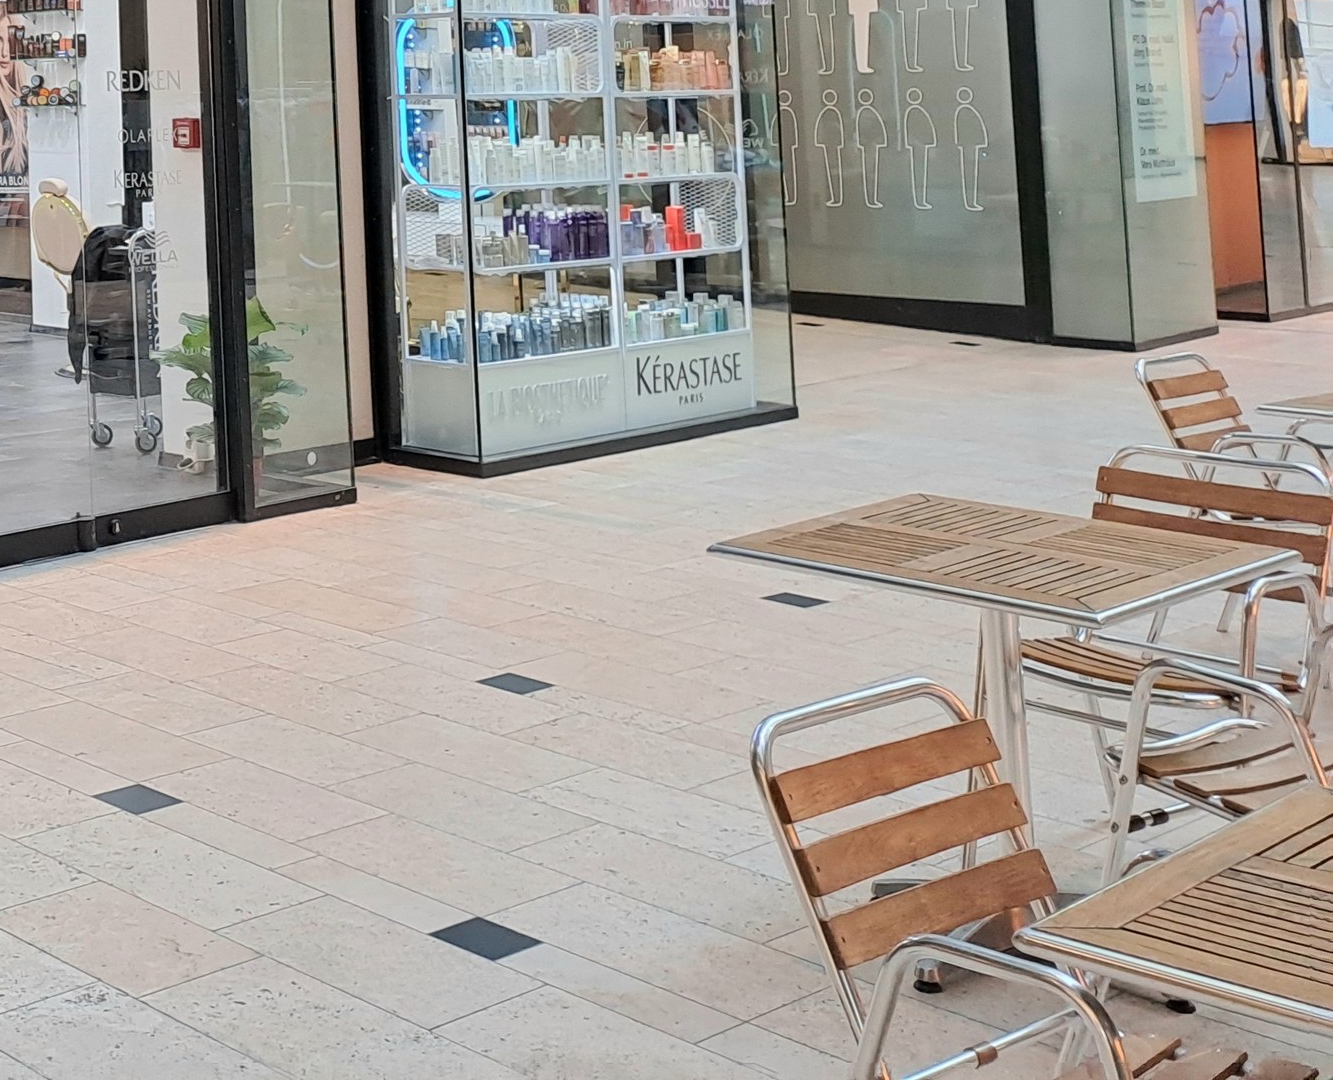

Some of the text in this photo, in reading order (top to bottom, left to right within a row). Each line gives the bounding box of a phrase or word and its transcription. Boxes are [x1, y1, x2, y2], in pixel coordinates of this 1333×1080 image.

[105, 69, 182, 92] REDKEN
[635, 352, 743, 396] KÉRASTASE
[678, 392, 704, 406] PARIS
